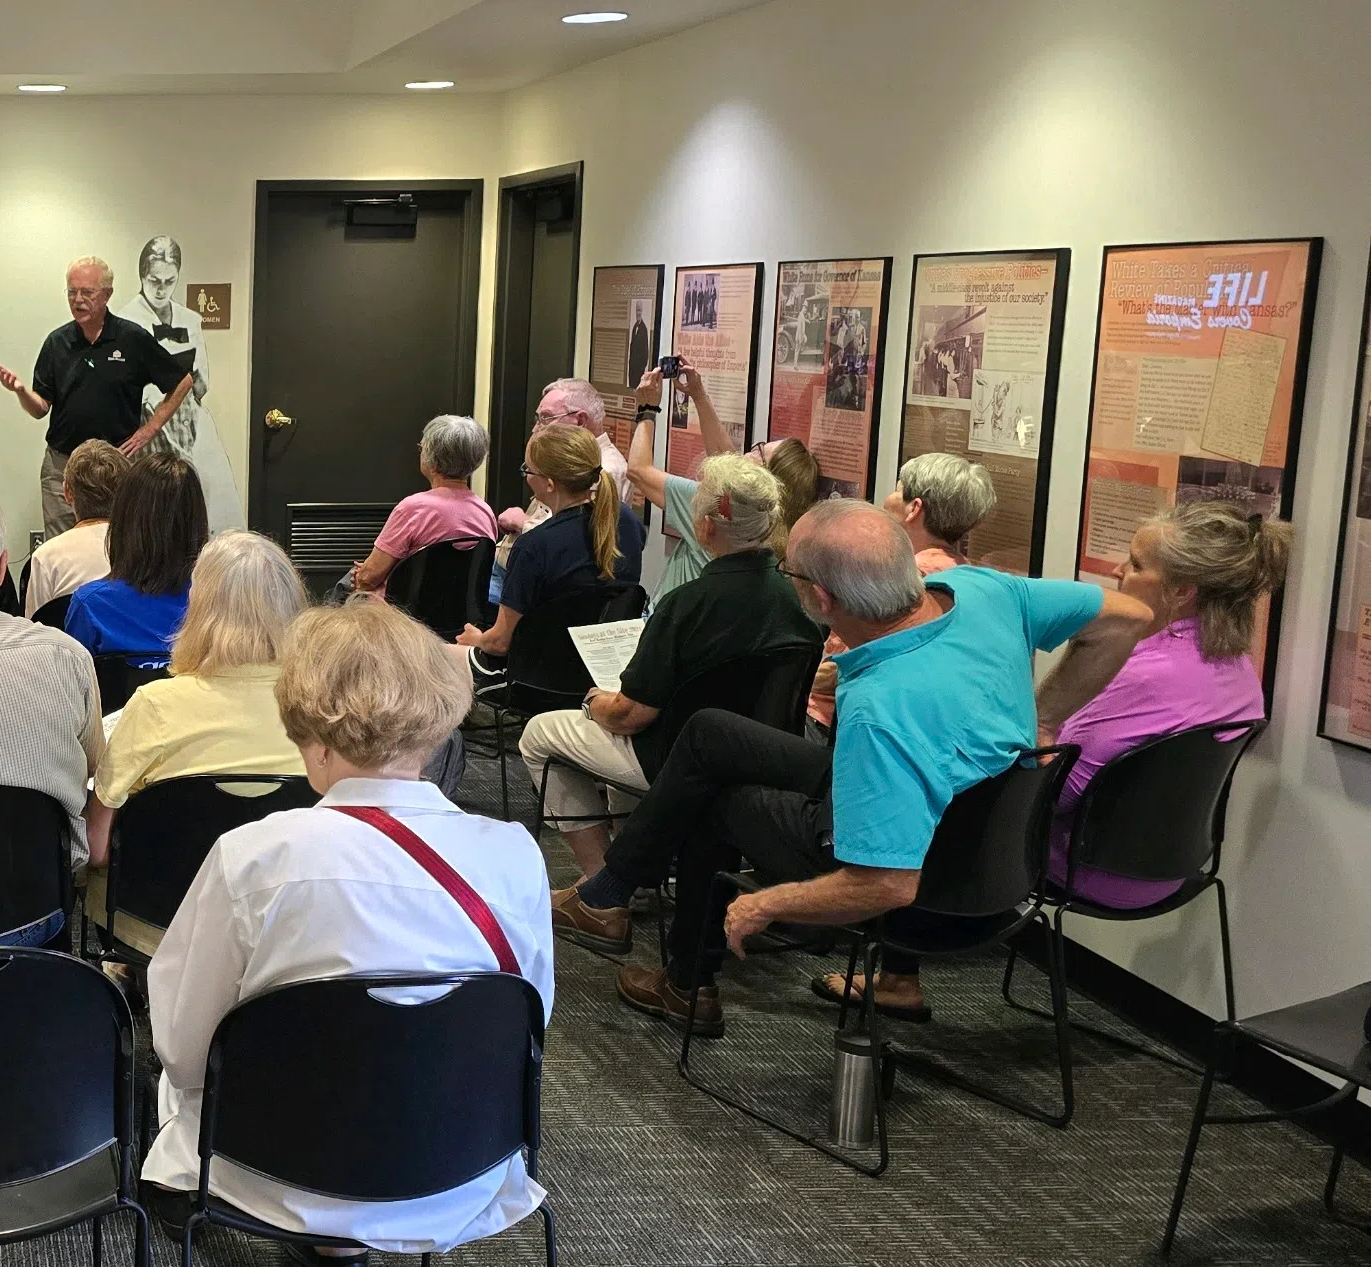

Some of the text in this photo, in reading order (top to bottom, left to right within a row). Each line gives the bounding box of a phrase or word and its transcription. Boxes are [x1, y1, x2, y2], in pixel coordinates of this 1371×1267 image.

[823, 269, 850, 283] Governor
[850, 269, 858, 282] of
[858, 269, 881, 282] Kansas
[955, 264, 1004, 281] Progressive
[1112, 261, 1146, 279] White
[1150, 260, 1186, 279] Takes
[1191, 264, 1198, 278] a
[972, 282, 990, 293] revolt
[991, 282, 1015, 294] against
[1109, 280, 1150, 298] Review
[1157, 280, 1169, 295] of
[965, 293, 974, 303] the
[975, 293, 1001, 305] injustice
[1002, 293, 1009, 303] of
[1009, 294, 1020, 303] our
[1155, 302, 1171, 315] the
[1214, 304, 1237, 317] with
[1242, 301, 1298, 318] ansas?"
